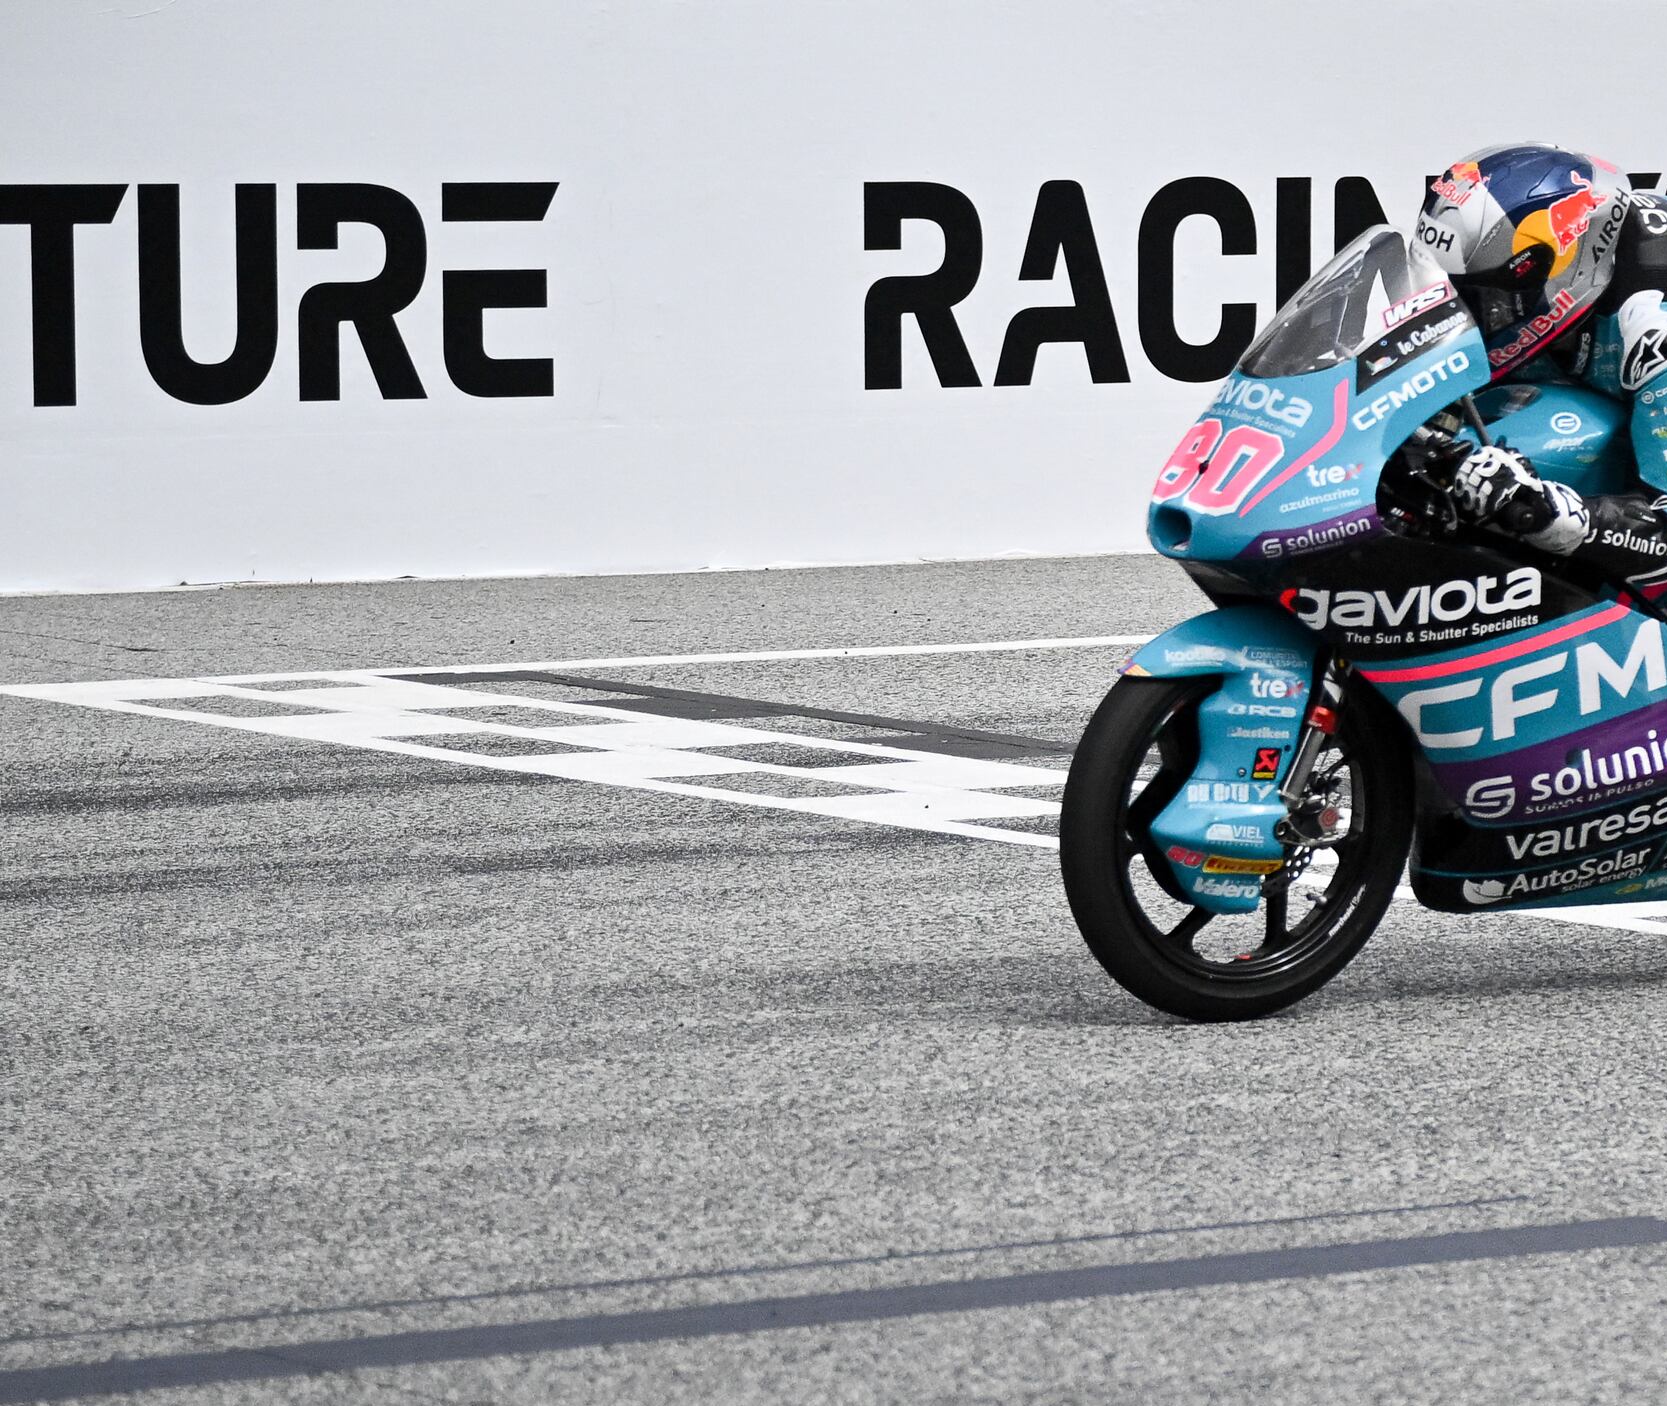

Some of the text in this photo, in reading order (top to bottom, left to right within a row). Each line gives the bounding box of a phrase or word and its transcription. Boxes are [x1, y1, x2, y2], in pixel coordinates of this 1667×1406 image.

[1590, 187, 1630, 265] AIROH
[1386, 283, 1447, 326] WRS
[1410, 311, 1468, 347] Cabanon
[1488, 322, 1537, 368] Red
[1533, 289, 1576, 334] Bull
[1352, 350, 1470, 432] CFMOTO
[1152, 418, 1284, 517] 80
[1279, 486, 1360, 514] azulmarino
[1286, 516, 1372, 549] solunion
[1280, 566, 1542, 630] gaviota
[1345, 613, 1540, 645] The Sun & Shutter Specialists
[1248, 704, 1297, 718] RCB
[1232, 825, 1265, 839] VIEL
[1507, 846, 1652, 897] AutoSolar
[1562, 864, 1648, 895] solar energy
